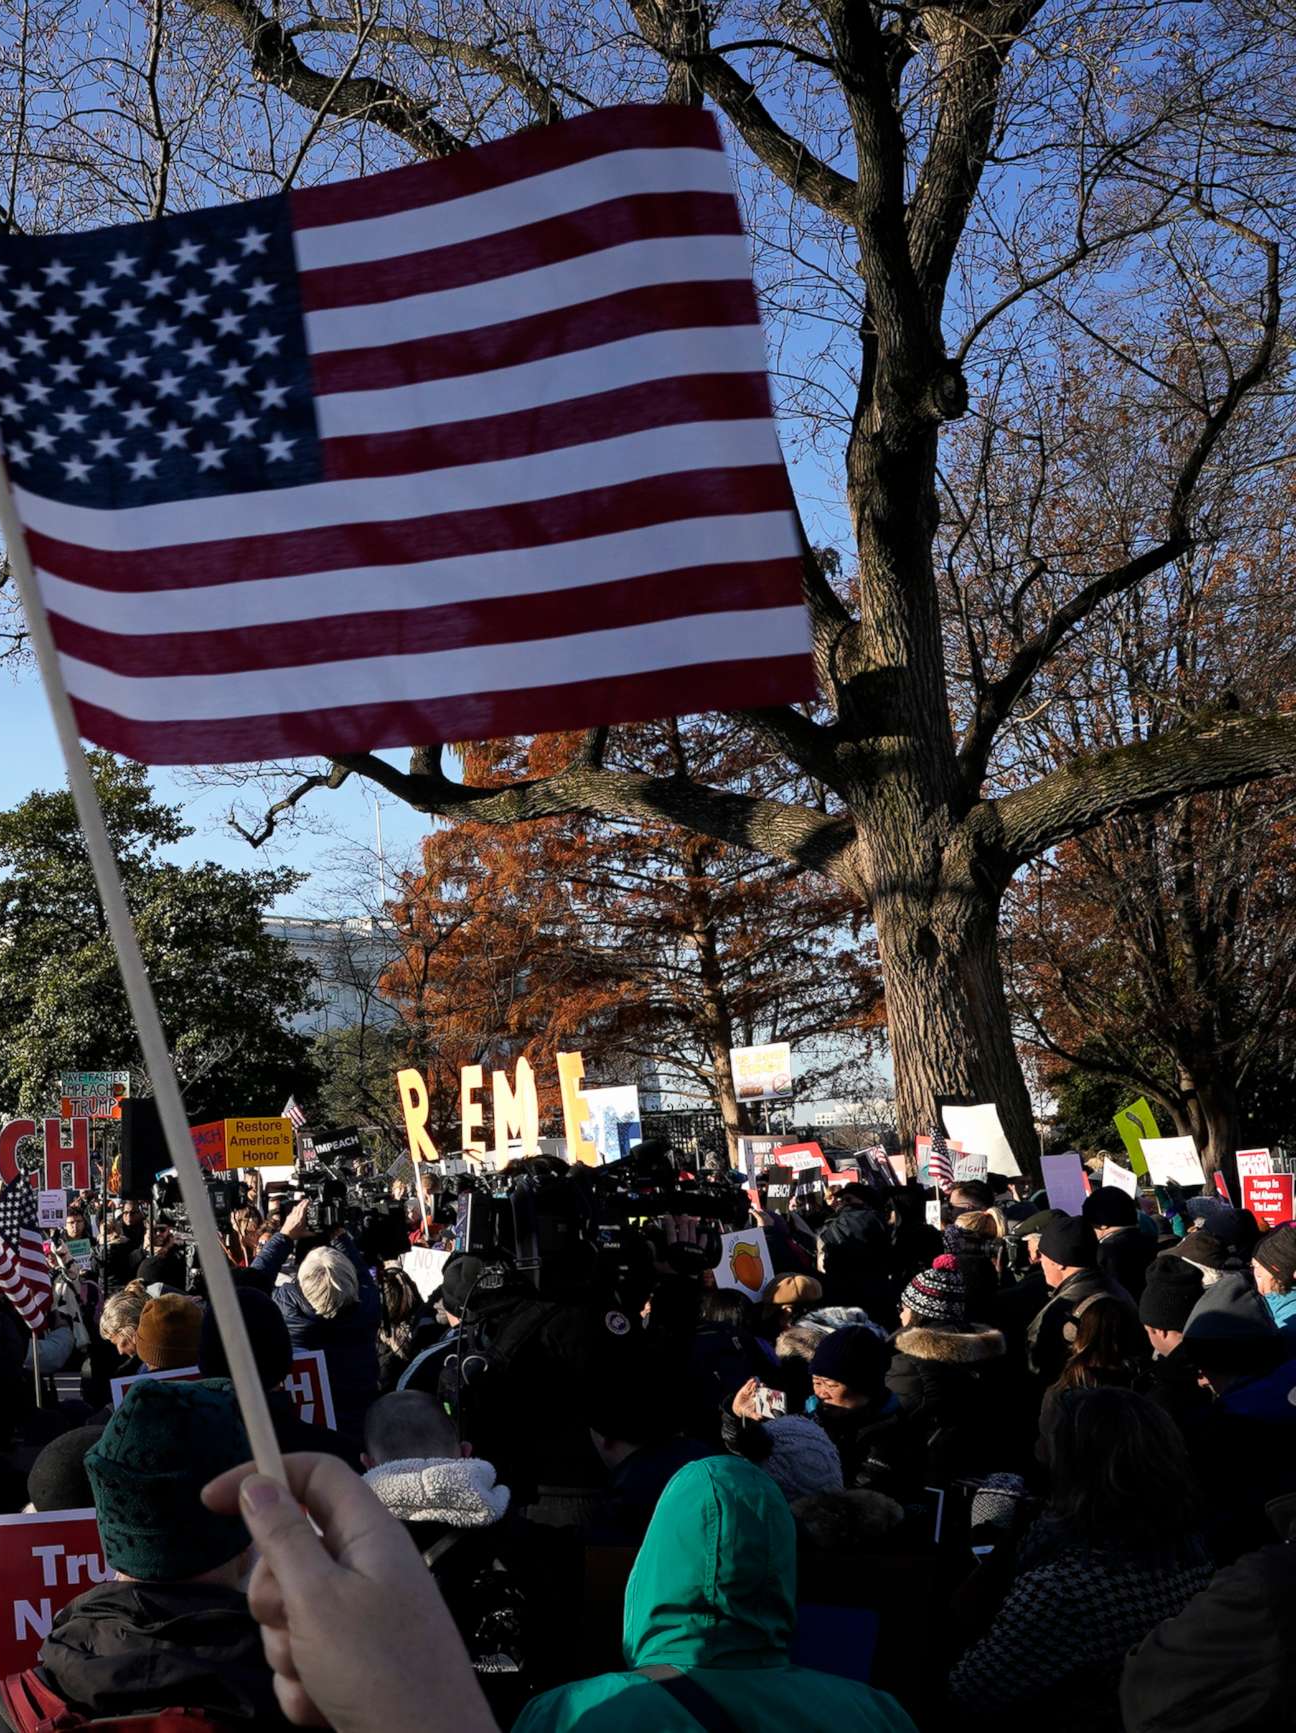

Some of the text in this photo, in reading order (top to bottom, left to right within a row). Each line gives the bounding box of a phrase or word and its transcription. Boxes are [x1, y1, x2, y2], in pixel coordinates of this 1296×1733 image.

[61, 1084, 114, 1097] IMPEACH
[70, 1097, 118, 1117] TRUMP
[236, 1120, 282, 1133] Restore
[230, 1134, 290, 1147] America's
[315, 1135, 359, 1154] IMPEACH
[752, 1142, 771, 1154] UMP
[242, 1150, 279, 1162] Honor
[31, 1544, 116, 1586] Tru
